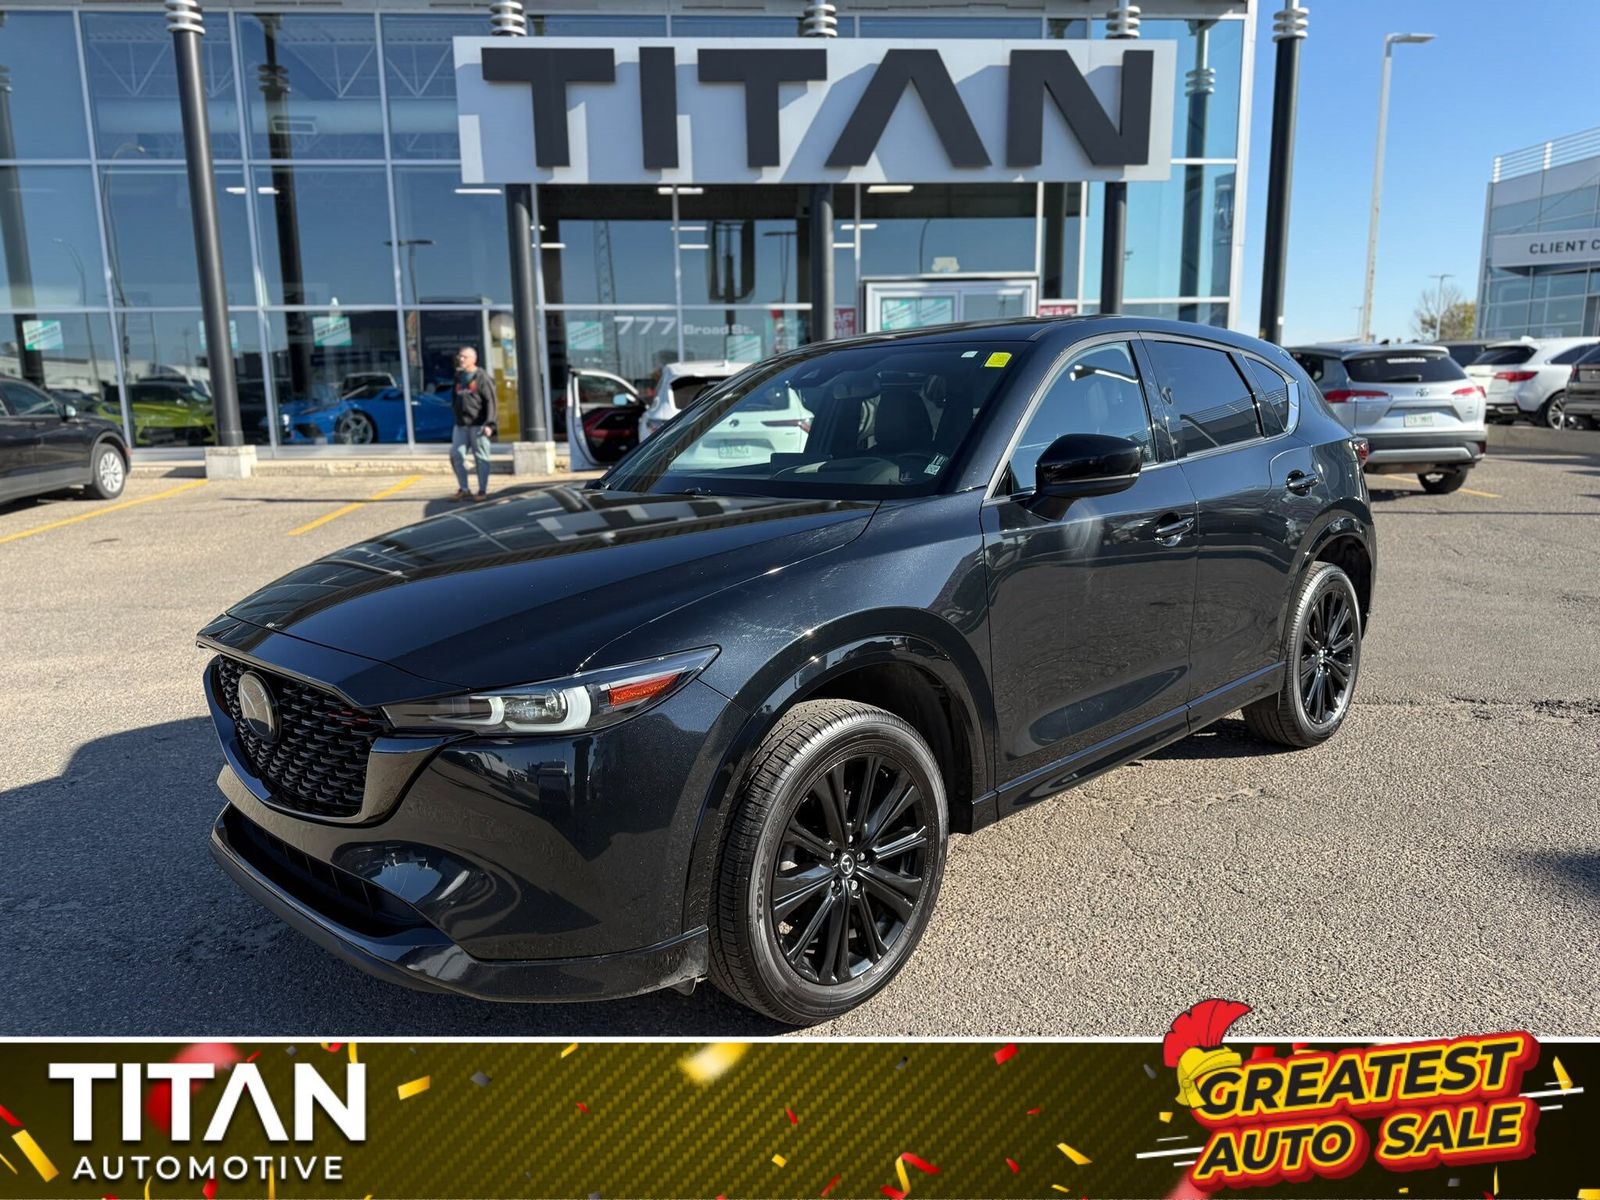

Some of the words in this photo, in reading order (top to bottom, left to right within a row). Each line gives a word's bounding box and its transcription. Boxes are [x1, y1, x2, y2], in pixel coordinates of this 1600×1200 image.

[481, 46, 1154, 168] TITAN
[1529, 239, 1587, 255] CLIENT
[614, 316, 677, 335] 777
[683, 324, 728, 335] Broad
[731, 324, 754, 335] St.
